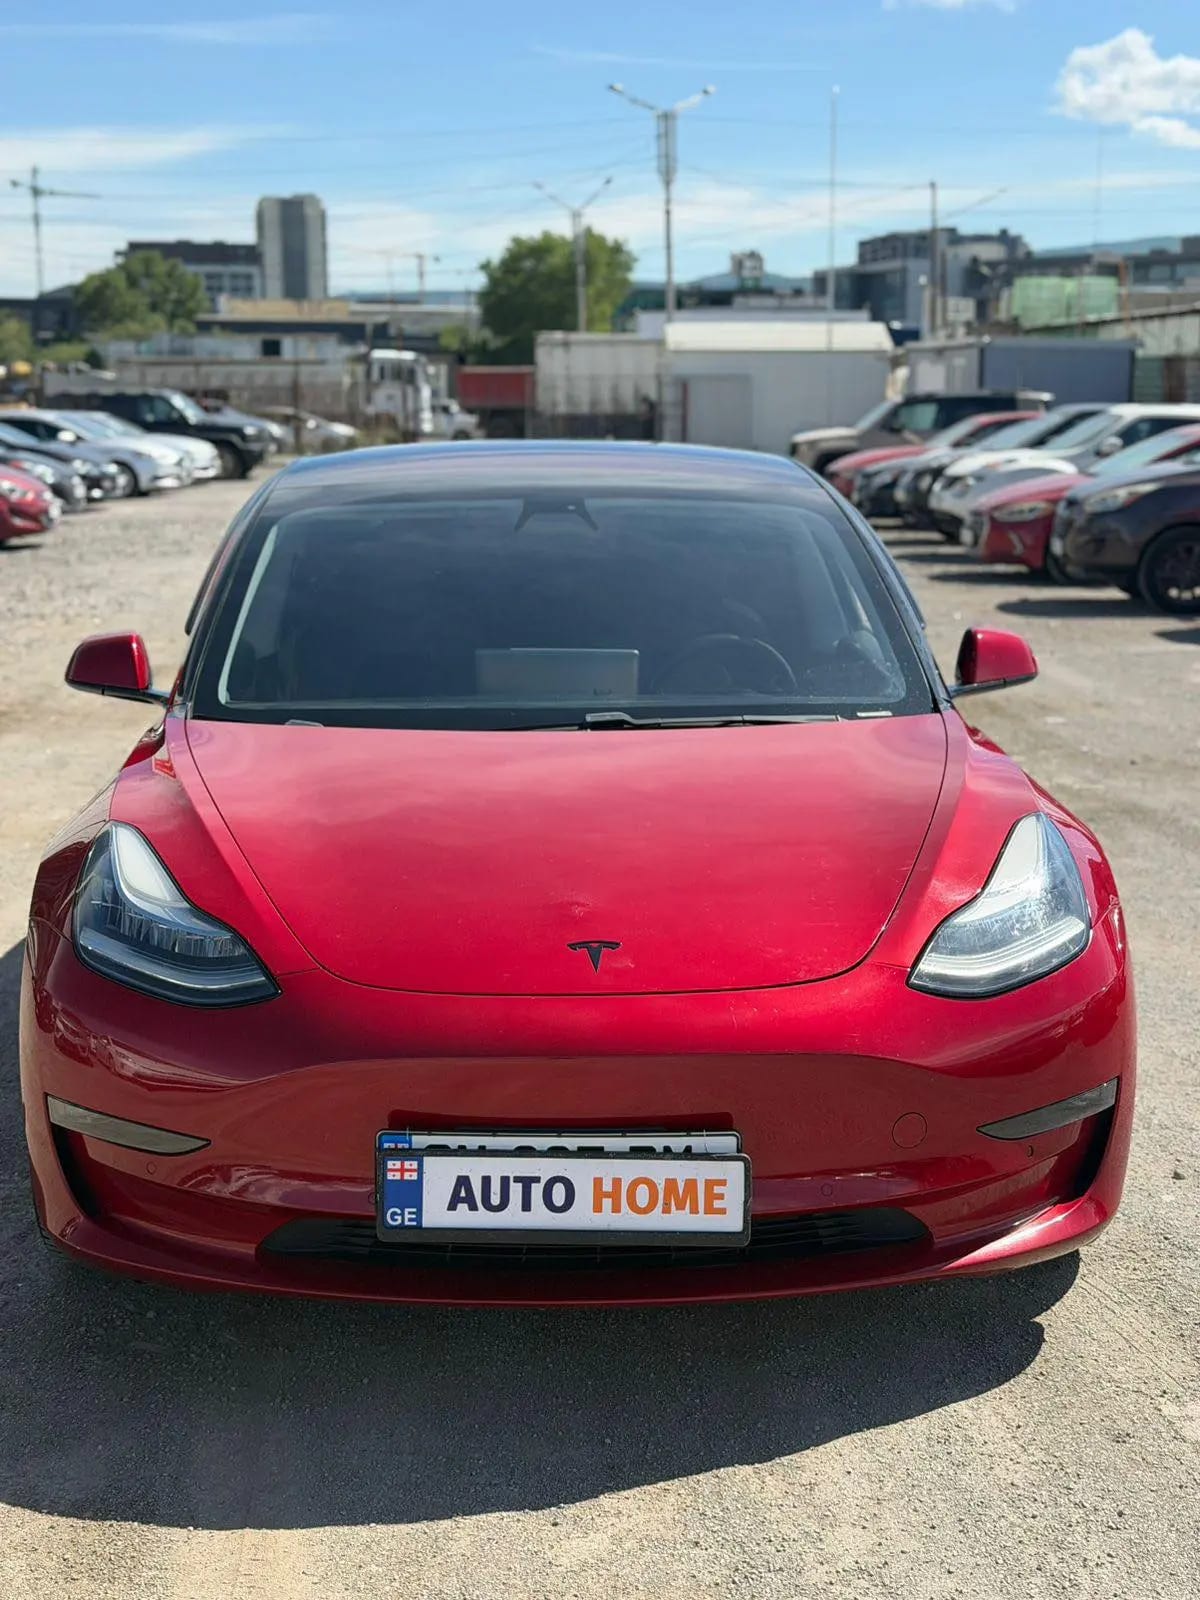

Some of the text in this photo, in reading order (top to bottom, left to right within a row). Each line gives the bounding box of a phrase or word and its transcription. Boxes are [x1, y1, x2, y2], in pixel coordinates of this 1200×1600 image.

[447, 1175, 727, 1215] AUTO HOME
[386, 1207, 417, 1226] GE
